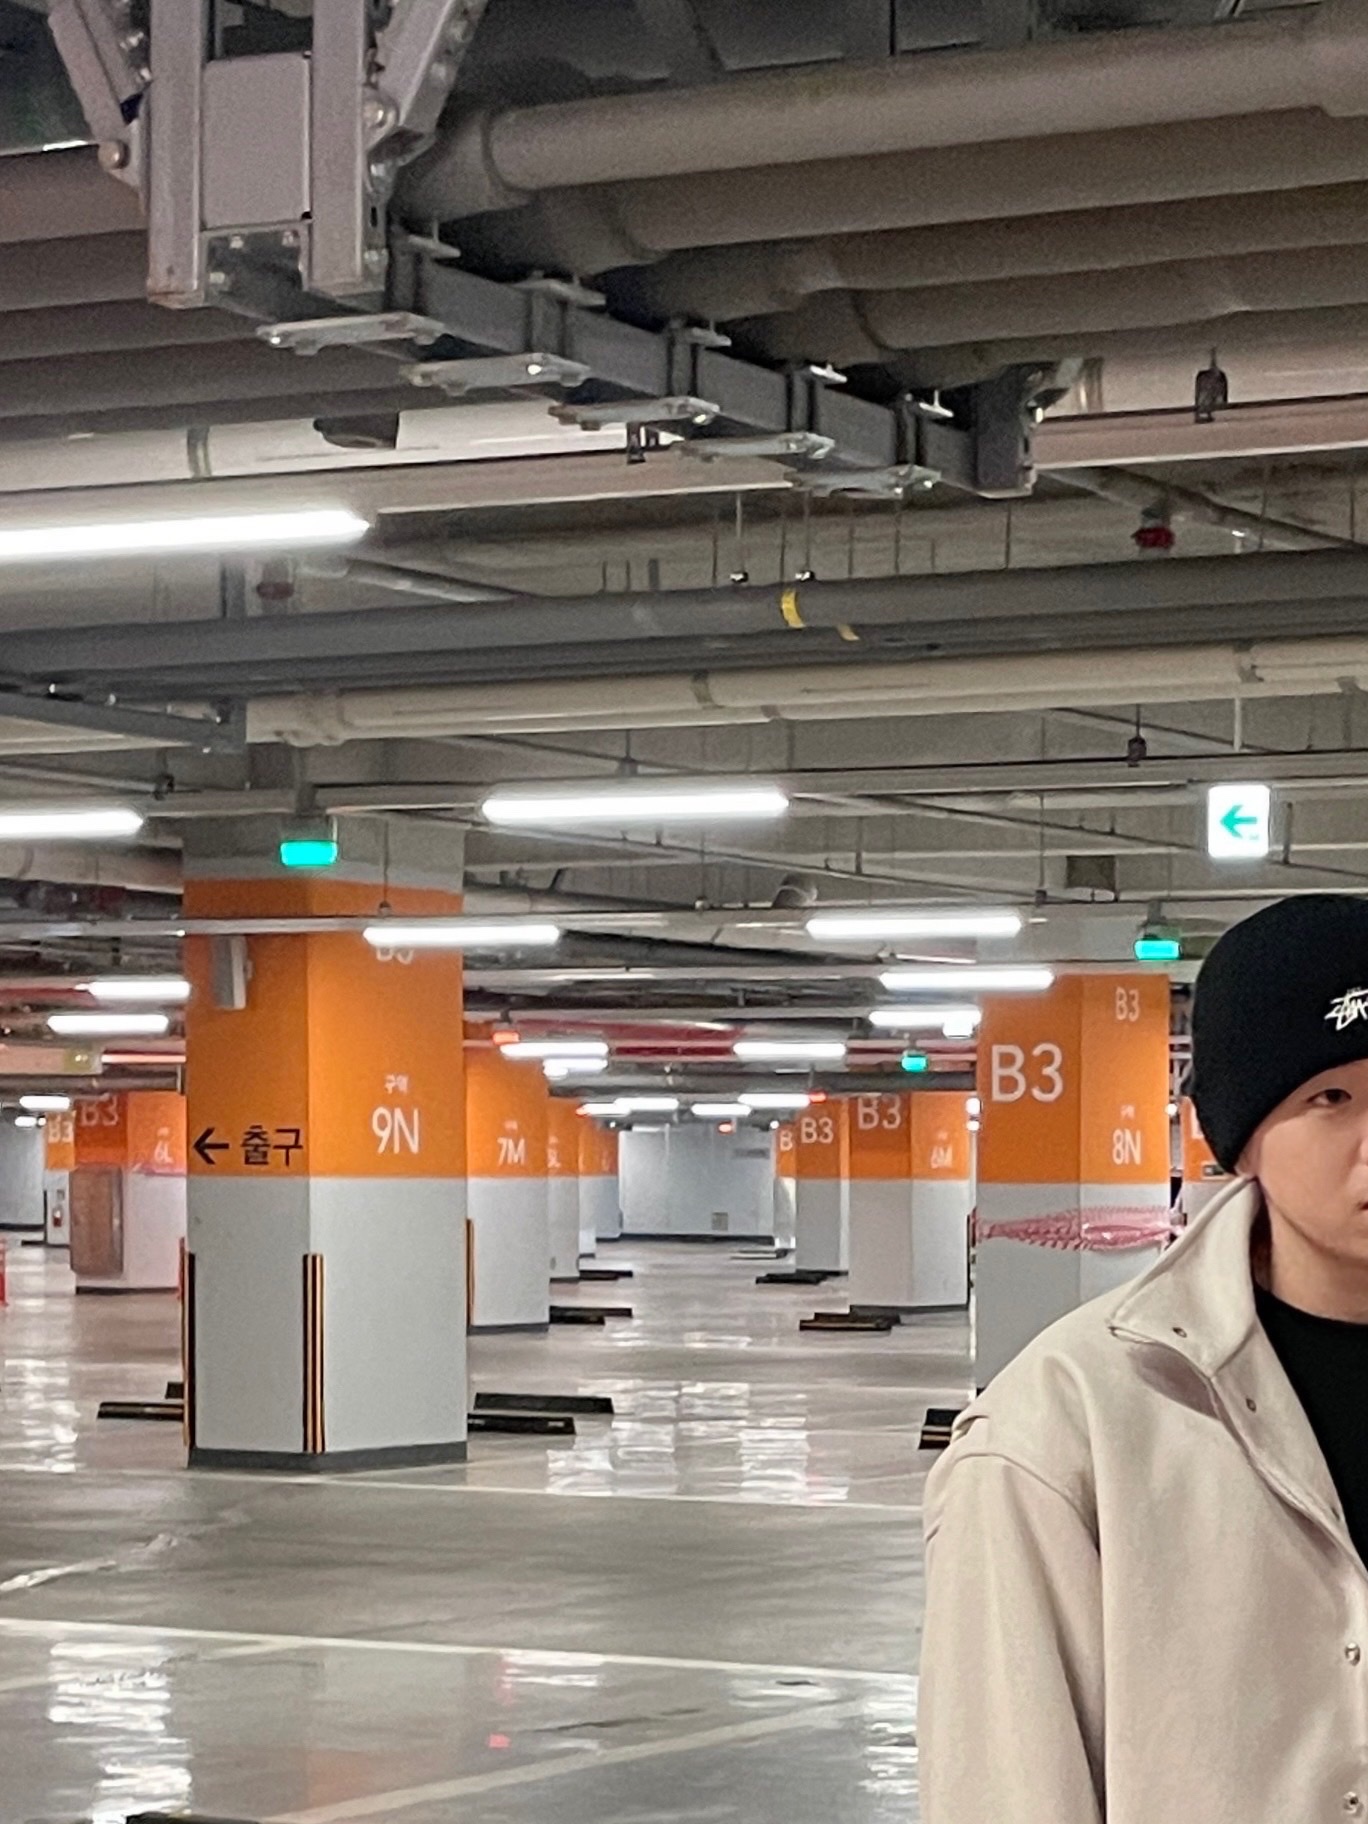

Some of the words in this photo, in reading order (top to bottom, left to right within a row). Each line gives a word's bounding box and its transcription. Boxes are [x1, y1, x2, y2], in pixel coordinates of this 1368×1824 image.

[1115, 986, 1140, 1022] B3
[990, 1042, 1064, 1102] B3
[371, 1105, 420, 1155] 9N
[800, 1117, 834, 1144] B3
[857, 1094, 902, 1131] B3
[241, 1124, 304, 1167] 출구
[496, 1136, 526, 1167] 7M
[1112, 1128, 1142, 1165] 8N
